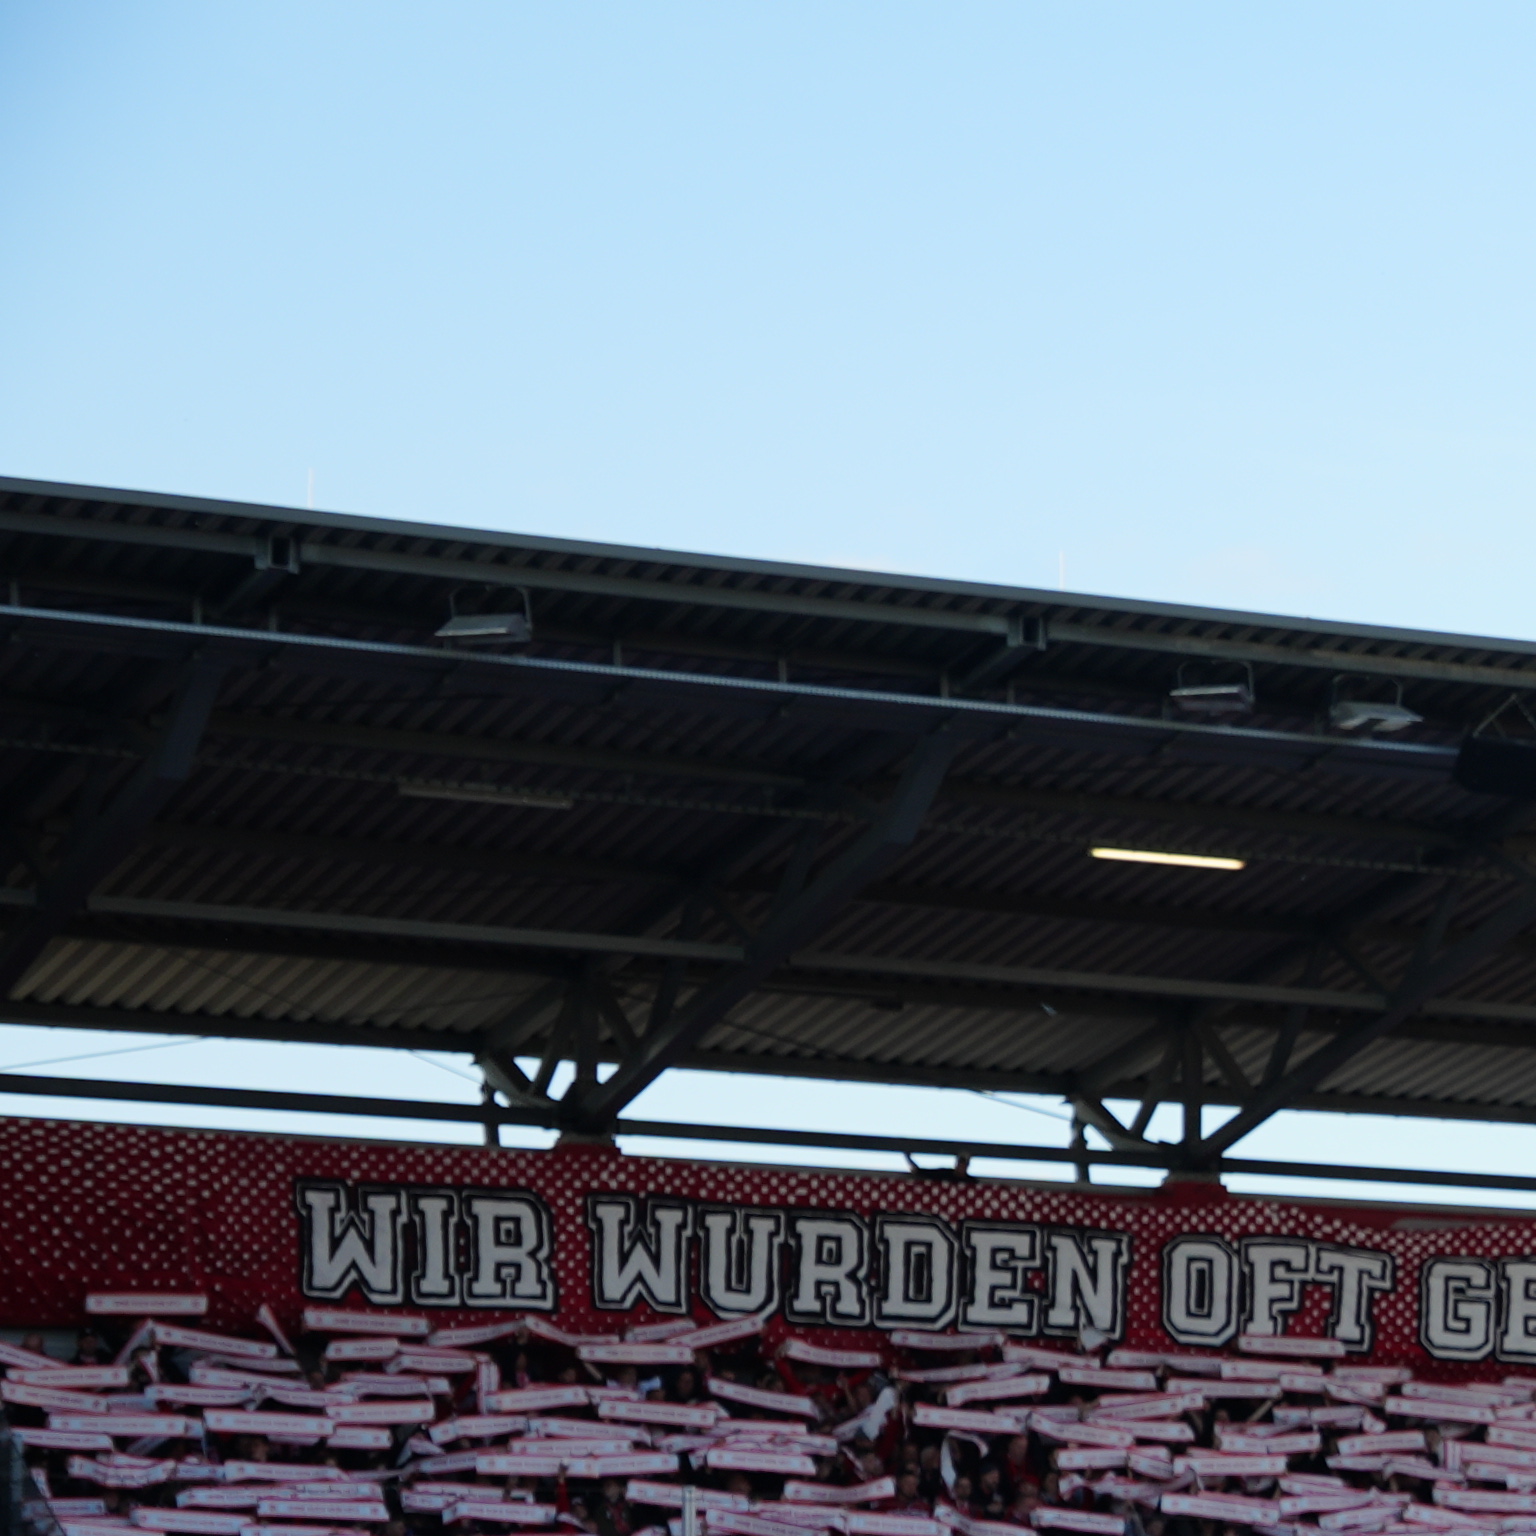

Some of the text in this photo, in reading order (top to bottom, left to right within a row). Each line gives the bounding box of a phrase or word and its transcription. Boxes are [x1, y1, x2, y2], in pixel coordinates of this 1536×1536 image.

[299, 1181, 553, 1310] WIR
[588, 1197, 1129, 1342] WURDEN
[1162, 1233, 1392, 1354] OFT
